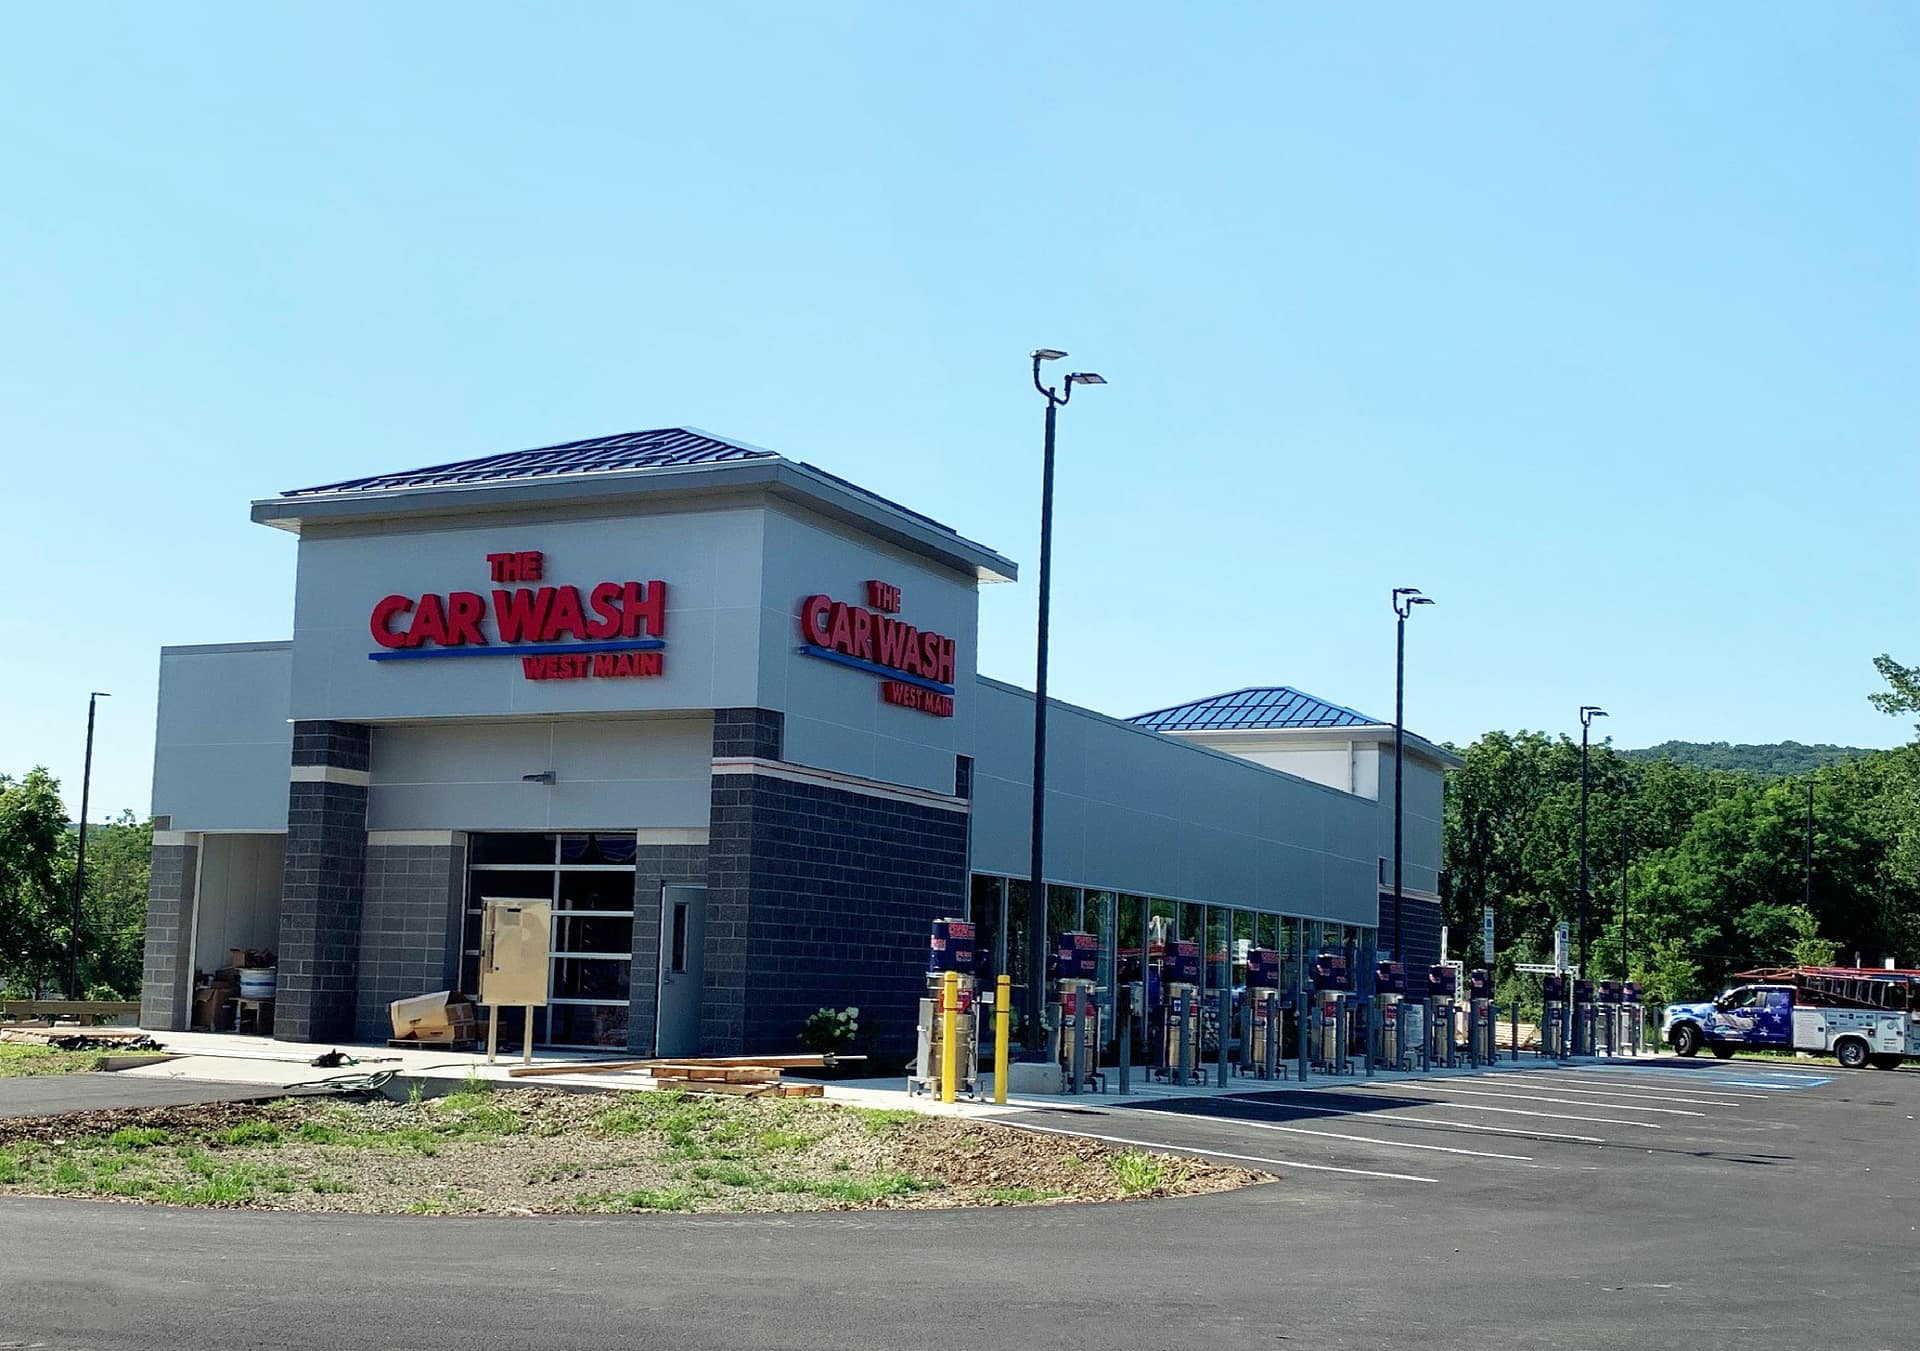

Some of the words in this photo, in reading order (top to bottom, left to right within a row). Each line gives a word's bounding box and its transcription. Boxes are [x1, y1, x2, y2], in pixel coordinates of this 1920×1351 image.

[487, 551, 543, 582] THE
[869, 580, 901, 613] THE
[370, 592, 488, 649] CAR
[492, 580, 665, 643] WASH
[803, 595, 873, 659] CAR
[873, 614, 955, 684] WASH
[523, 655, 591, 680] WEST
[592, 653, 663, 678] MAIN
[885, 681, 922, 709] WEST
[922, 691, 954, 717] MAIN
